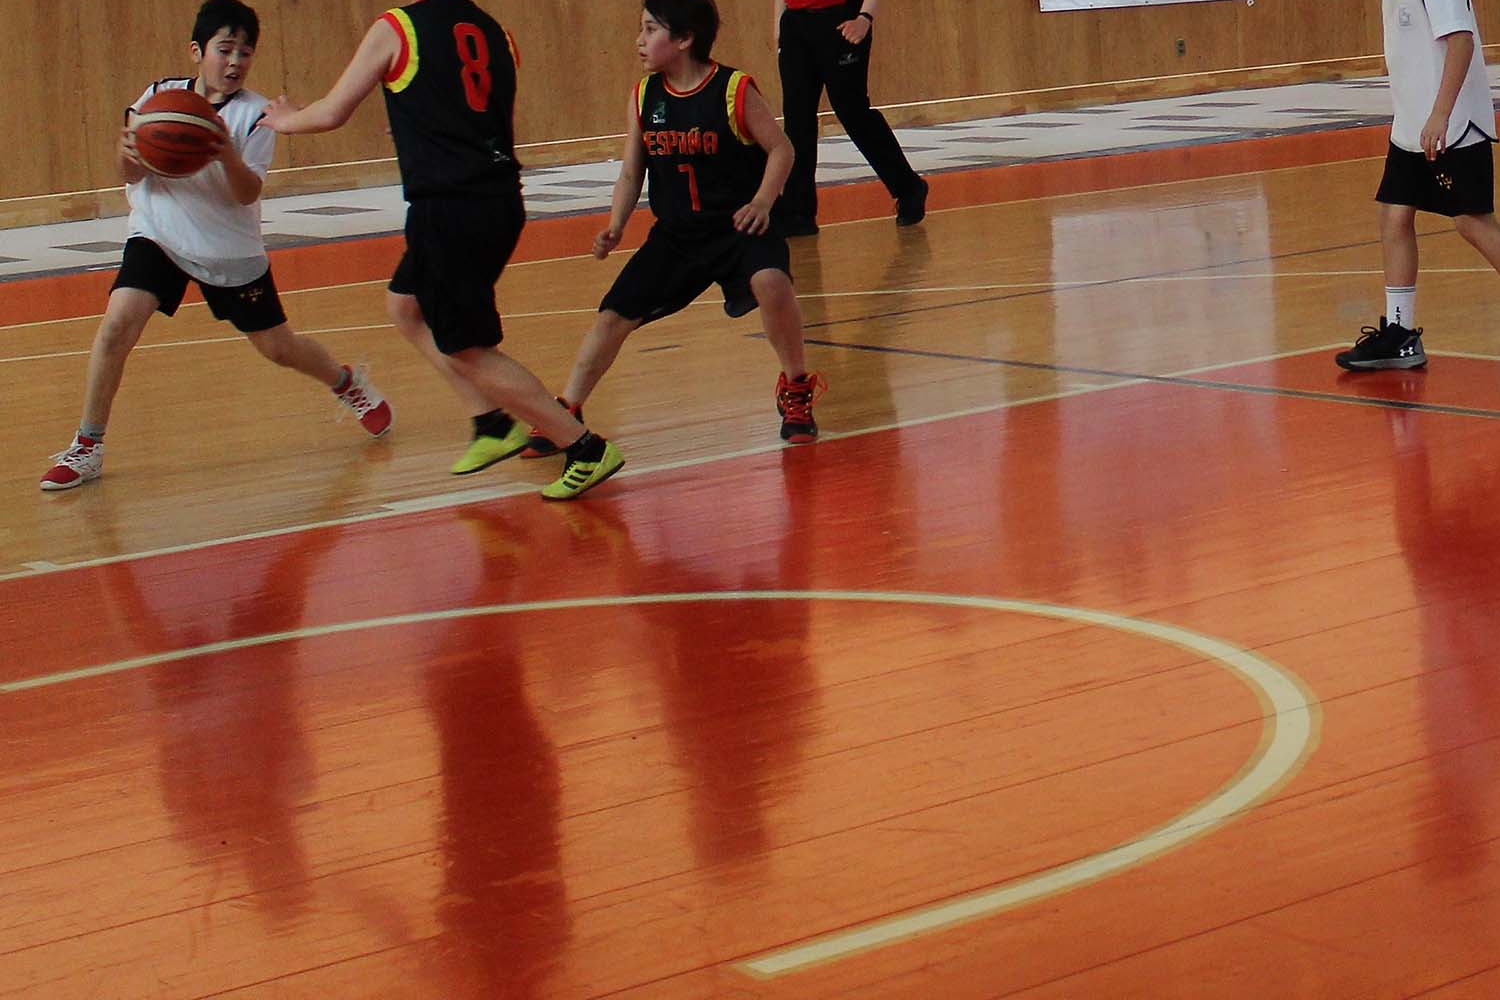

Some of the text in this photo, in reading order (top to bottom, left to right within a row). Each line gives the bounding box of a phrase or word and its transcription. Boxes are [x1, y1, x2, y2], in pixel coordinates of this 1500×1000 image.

[453, 23, 492, 112] 8
[643, 127, 719, 156] ESPAÑA
[677, 164, 701, 212] 7
